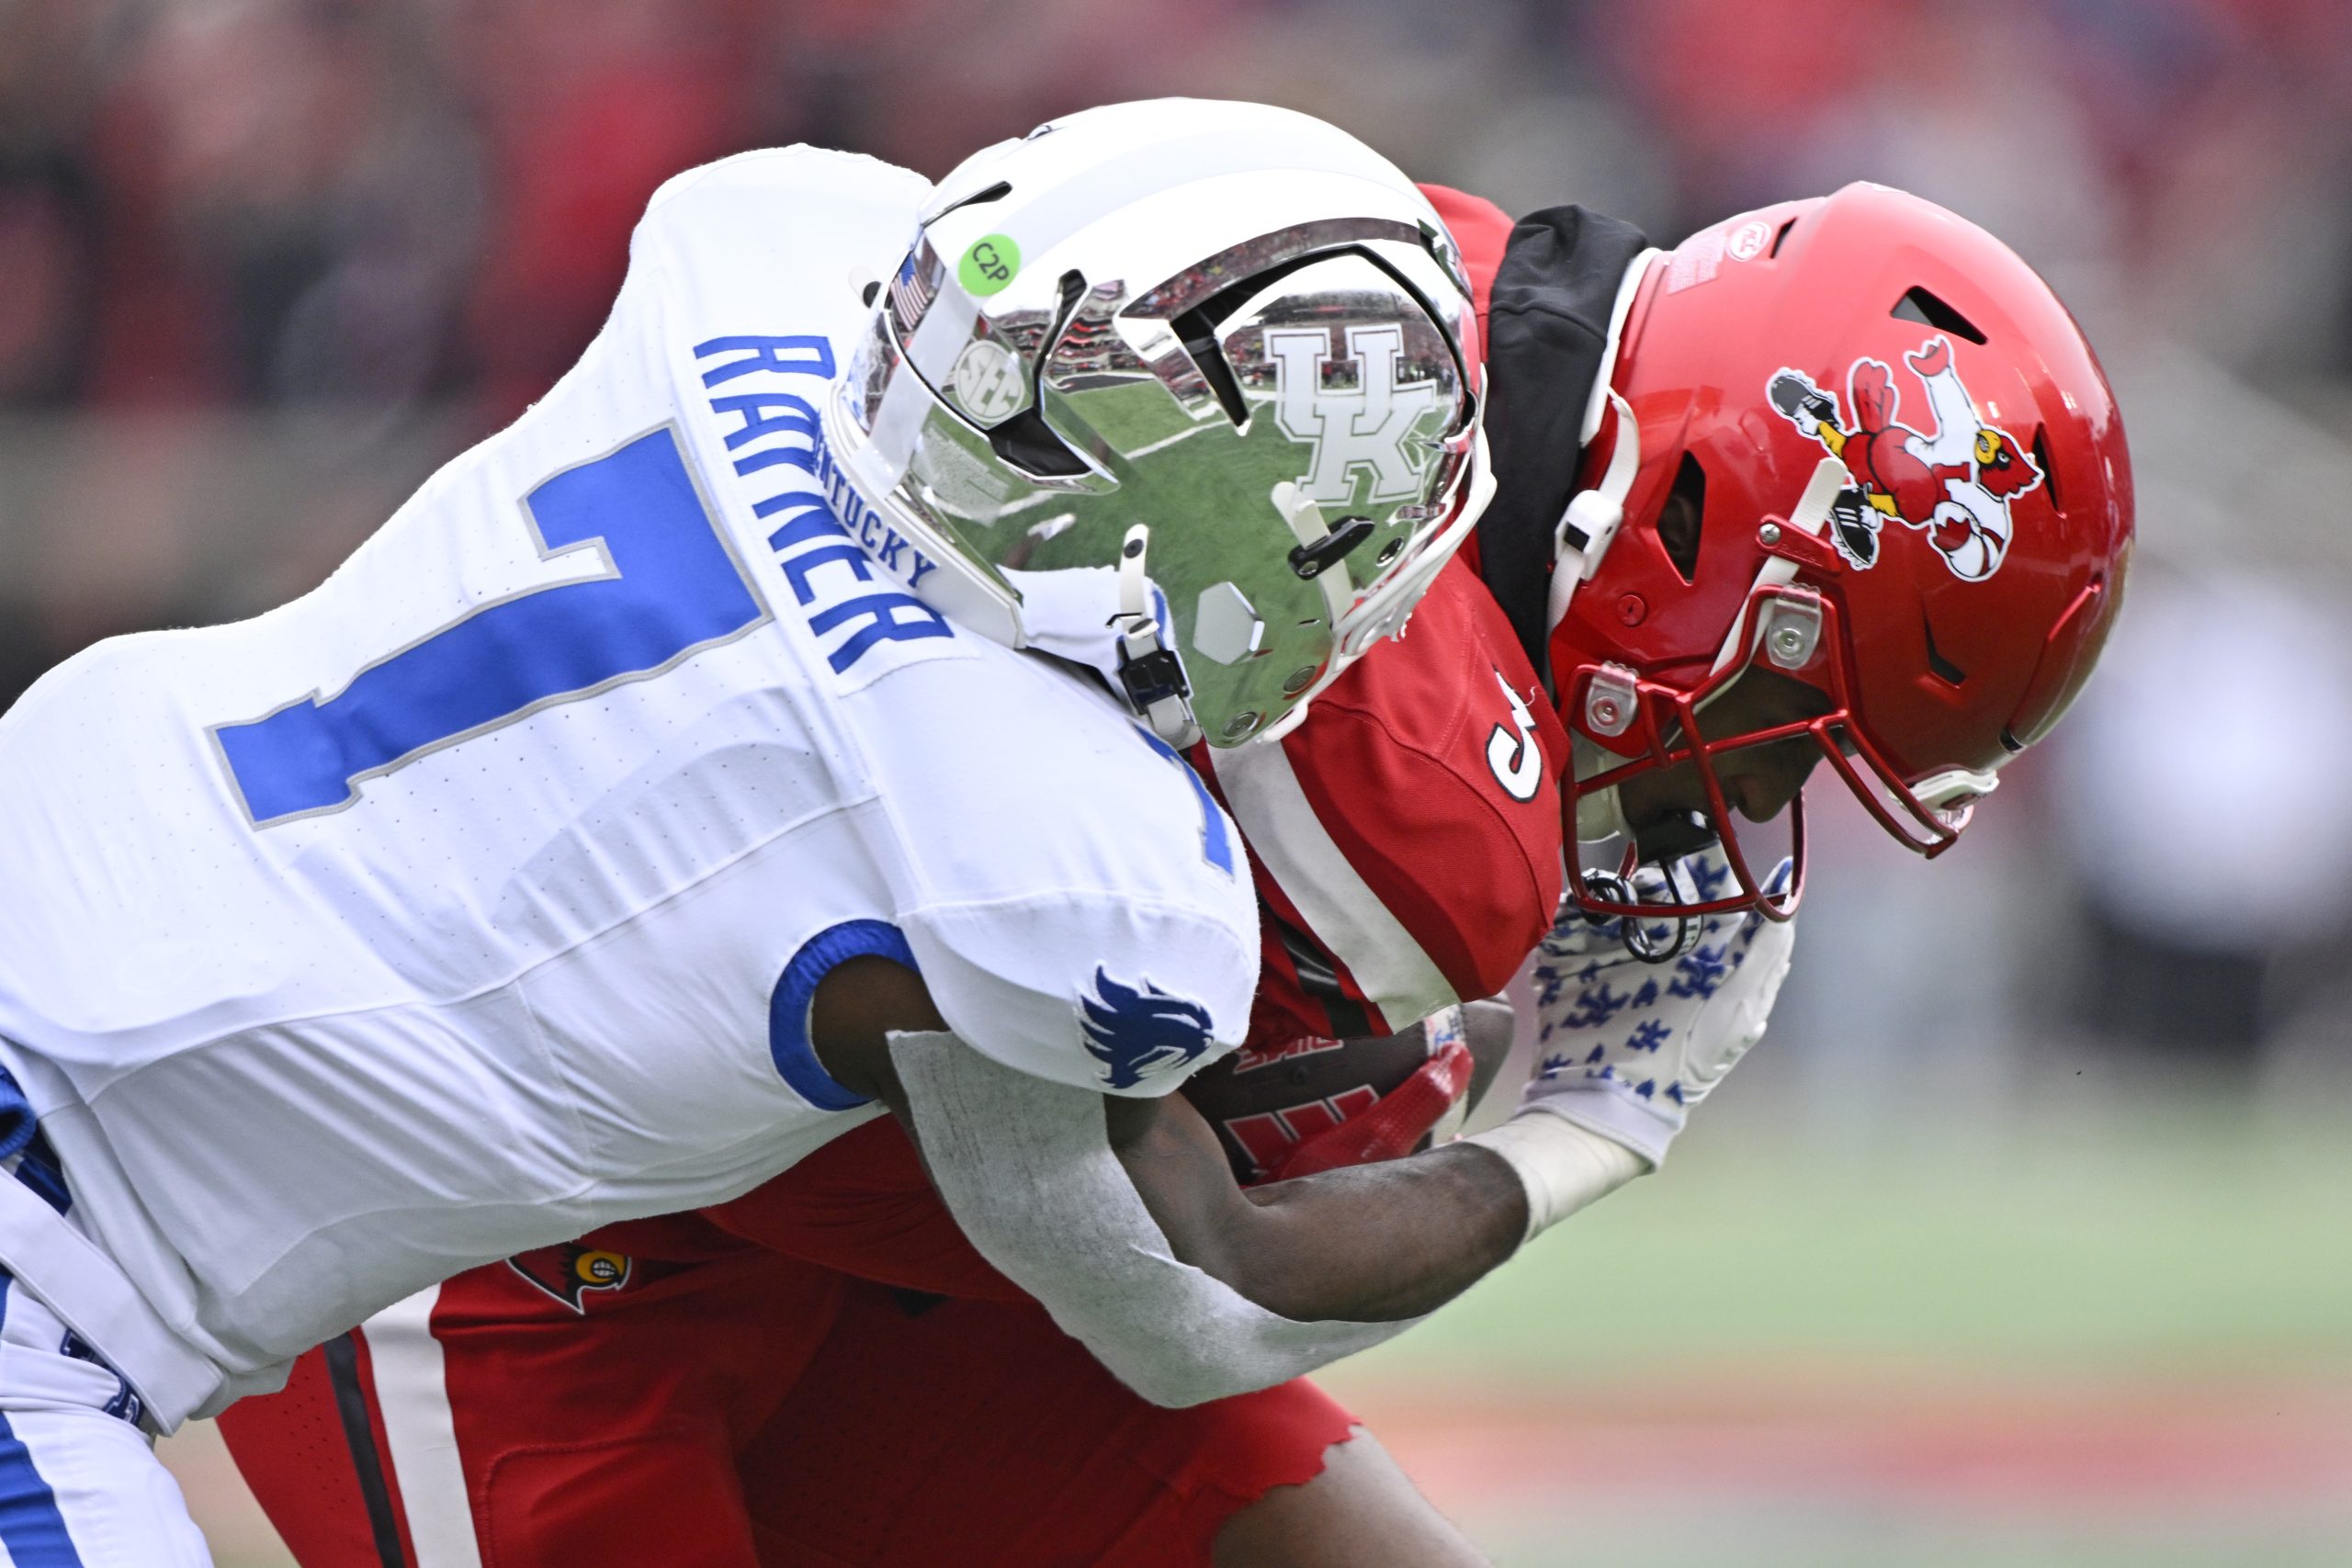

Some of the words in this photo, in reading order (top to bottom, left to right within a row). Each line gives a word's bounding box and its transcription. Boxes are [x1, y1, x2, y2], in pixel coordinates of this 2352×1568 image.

[972, 242, 1010, 283] C2P
[958, 347, 1023, 418] SEC
[1263, 322, 1437, 507] UK
[203, 417, 775, 831] 7
